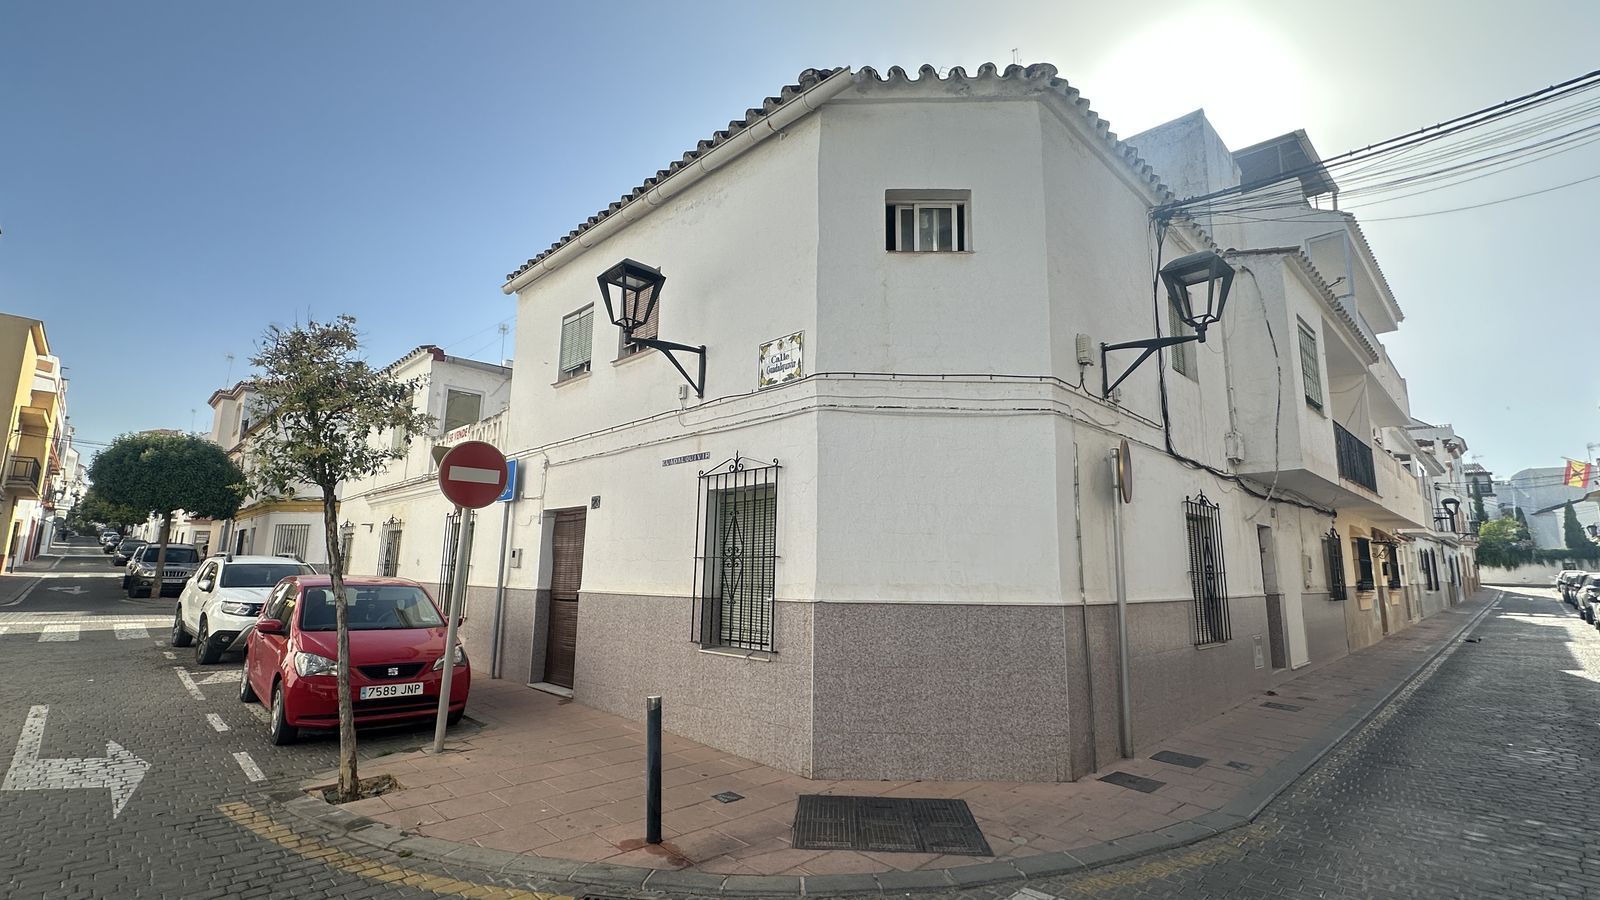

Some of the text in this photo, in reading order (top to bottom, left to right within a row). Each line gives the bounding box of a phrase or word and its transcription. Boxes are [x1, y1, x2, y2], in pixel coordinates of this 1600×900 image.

[771, 353, 790, 364] Calle
[368, 684, 421, 697] 7589 JNP
